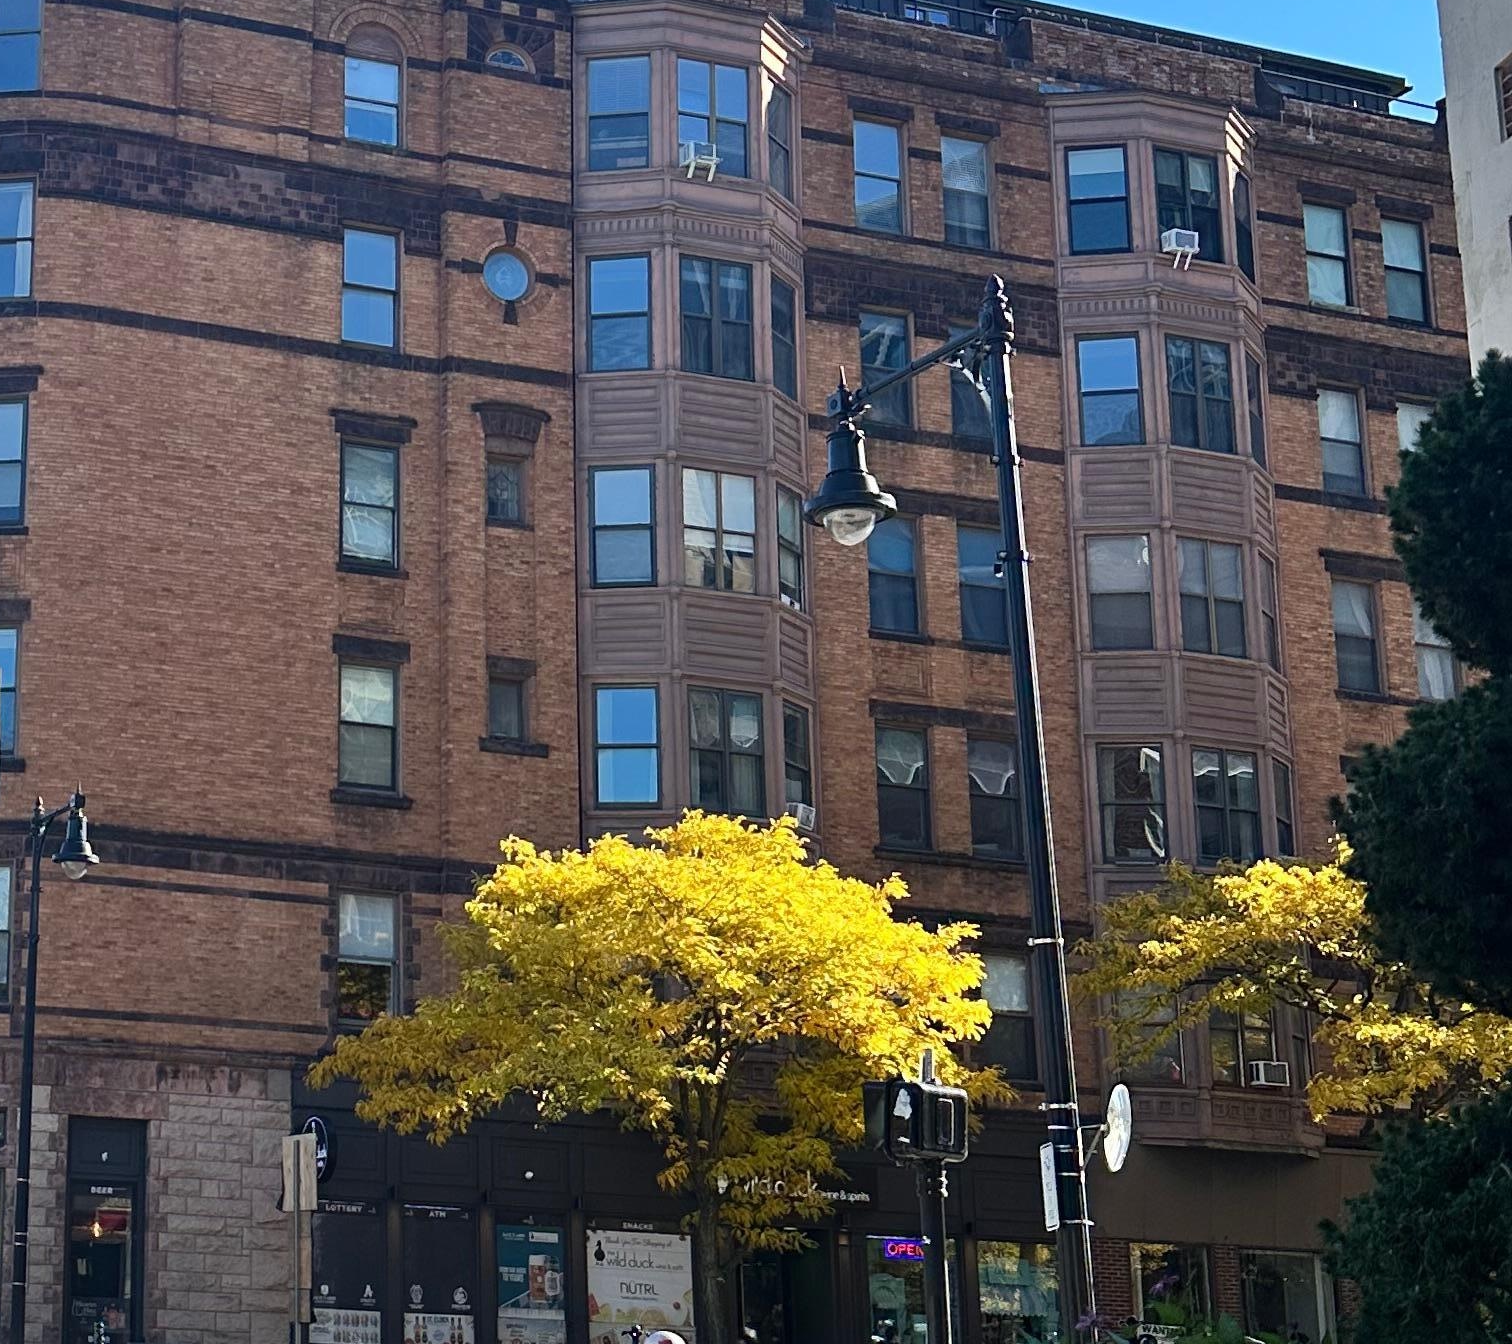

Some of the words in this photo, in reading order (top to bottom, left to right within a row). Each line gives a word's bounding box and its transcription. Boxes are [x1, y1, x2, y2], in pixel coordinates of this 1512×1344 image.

[325, 1203, 363, 1213] LOTTERY
[428, 1210, 446, 1218] ATM
[623, 1221, 653, 1230] SNACKS
[606, 1251, 627, 1268] wild
[628, 1251, 654, 1269] duck
